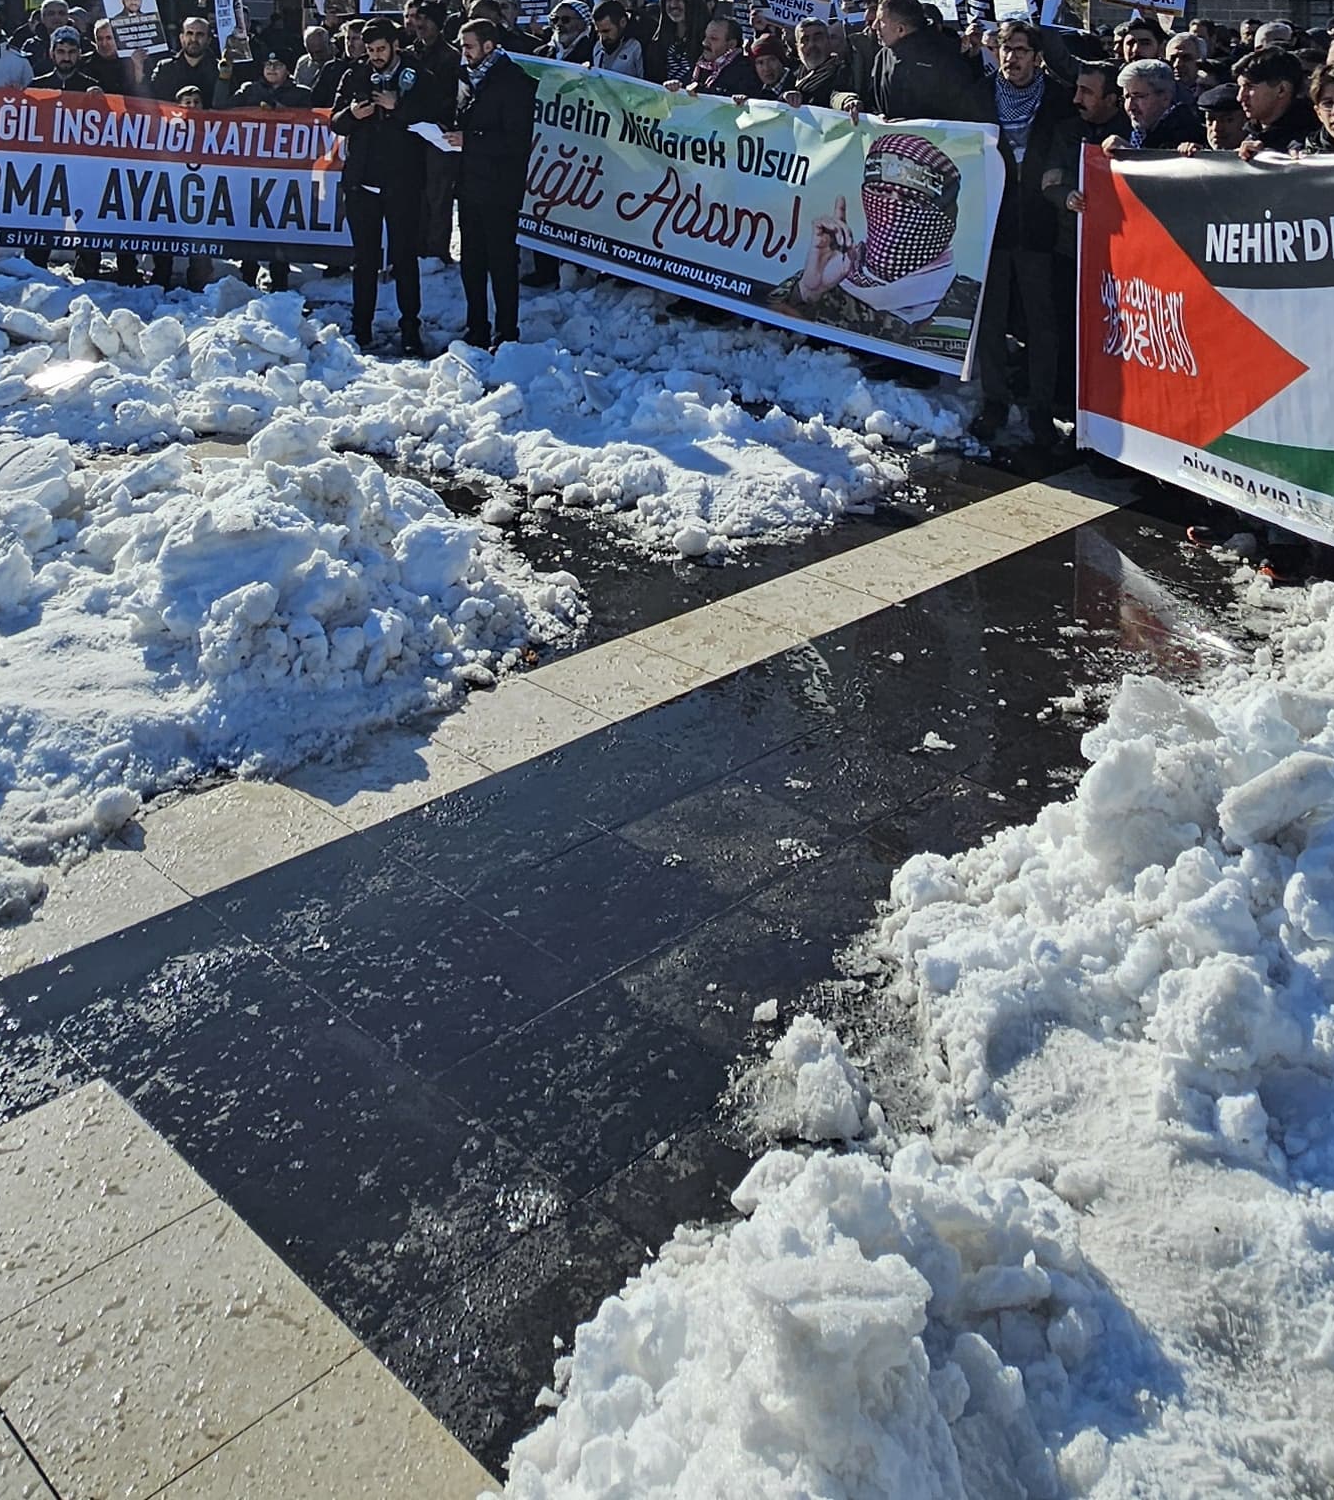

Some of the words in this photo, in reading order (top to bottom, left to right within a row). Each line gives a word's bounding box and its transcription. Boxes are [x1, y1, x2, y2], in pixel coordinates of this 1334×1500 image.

[53, 101, 197, 153] İNSANLIĞI
[202, 118, 347, 162] KATLEDİY
[532, 94, 611, 138] adetin
[619, 108, 727, 170] Mübarek
[737, 134, 811, 186] Olsun
[97, 162, 236, 227] AYAĞA
[617, 166, 802, 264] Adam!
[6, 231, 47, 247] SİVİL
[53, 234, 114, 250] TOPLUM
[119, 239, 225, 256] KURULUŞLARI
[539, 220, 578, 245] İSLAMİ
[580, 234, 609, 255] SİVİL
[611, 245, 664, 270] TOPLUM
[663, 257, 752, 296] KURULUŞLARI
